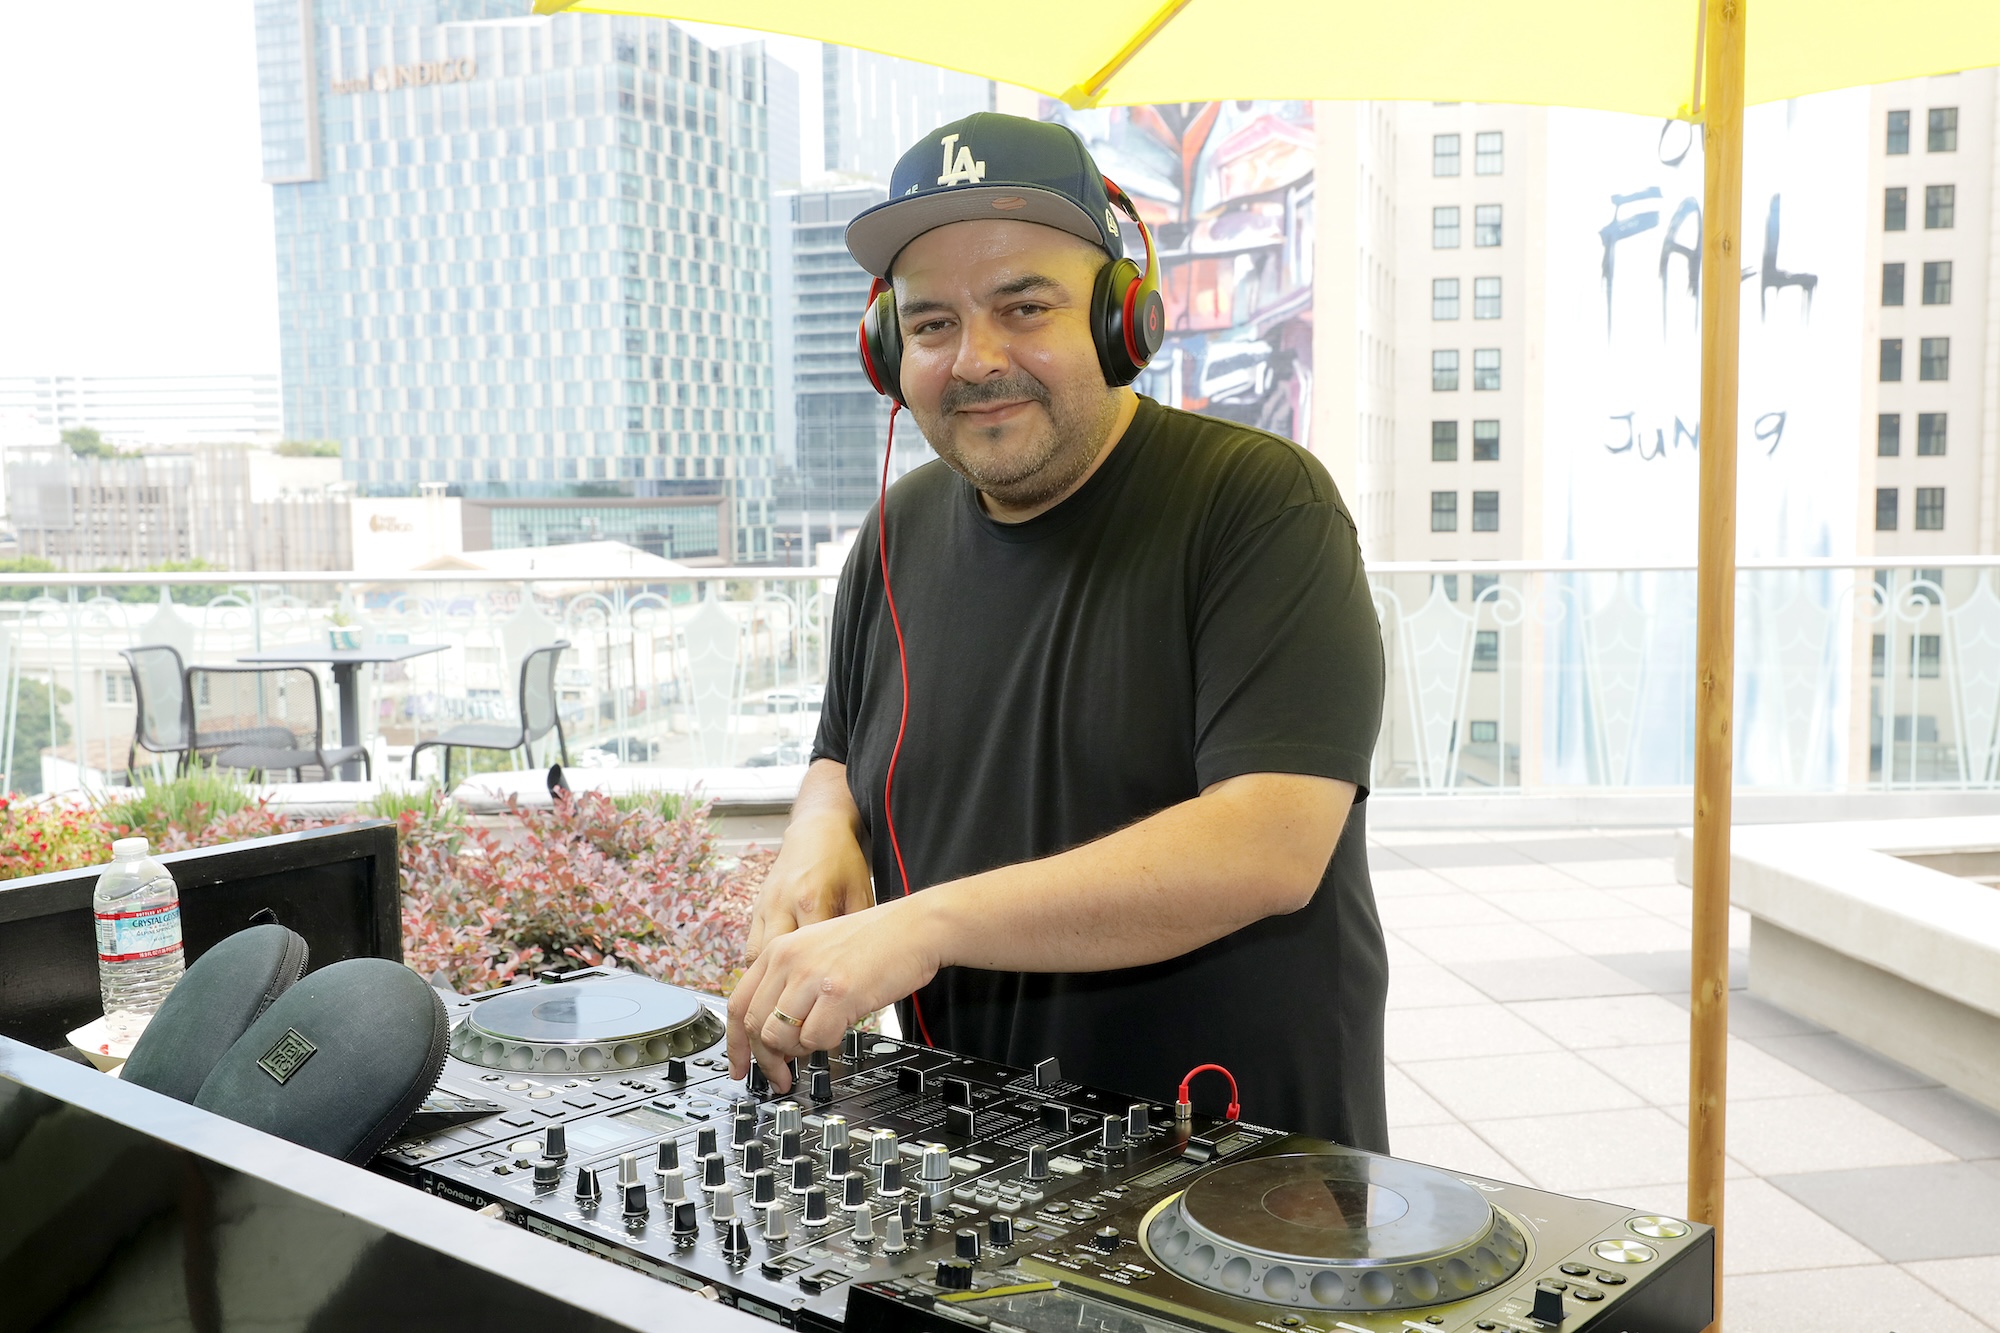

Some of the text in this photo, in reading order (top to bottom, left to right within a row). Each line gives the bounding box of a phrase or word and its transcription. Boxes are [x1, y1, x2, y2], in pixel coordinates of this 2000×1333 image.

[394, 55, 477, 88] INDIGO
[937, 134, 986, 186] LA
[1598, 186, 1818, 300] FAL
[1754, 411, 1788, 456] 9
[132, 916, 162, 928] CRYSTAL
[272, 1050, 293, 1071] YRS
[281, 1040, 305, 1062] TEN
[436, 1182, 475, 1203] Pioneer
[541, 1222, 553, 1231] CH4
[581, 1219, 648, 1244] Pioneer
[583, 1238, 596, 1249] CH3
[628, 1256, 641, 1267] CH2
[675, 1274, 688, 1285] CH1
